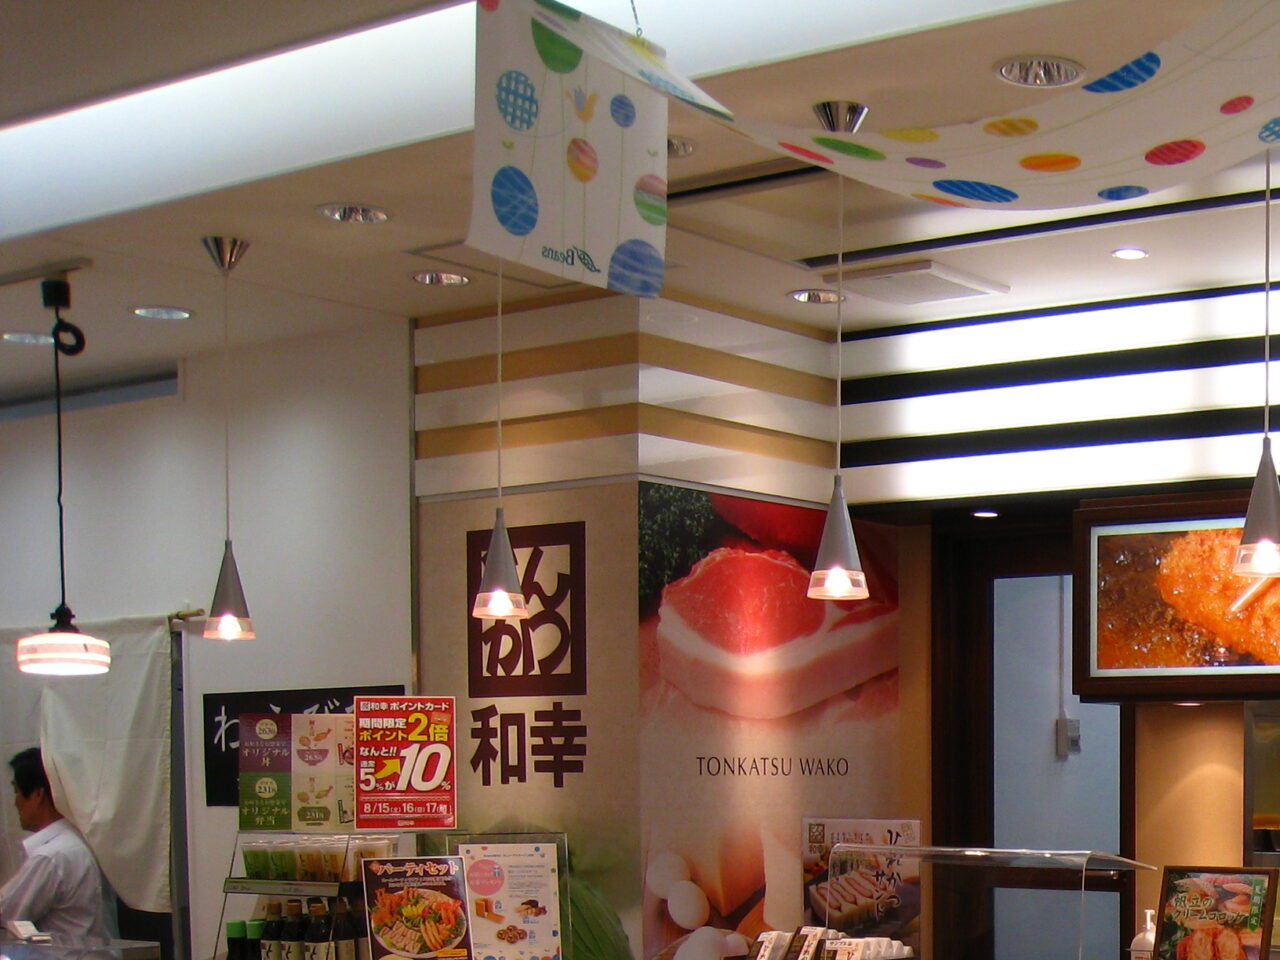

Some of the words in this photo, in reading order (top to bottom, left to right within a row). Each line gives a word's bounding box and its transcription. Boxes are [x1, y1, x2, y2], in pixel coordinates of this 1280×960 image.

[390, 702, 449, 711] ポイントカード
[359, 718, 407, 729] 期間限定
[470, 702, 588, 788] 和幸
[242, 749, 290, 757] オリジナル
[696, 756, 792, 776] TONKATSU
[800, 757, 850, 777] WAKO
[377, 861, 459, 877] パーティセット
